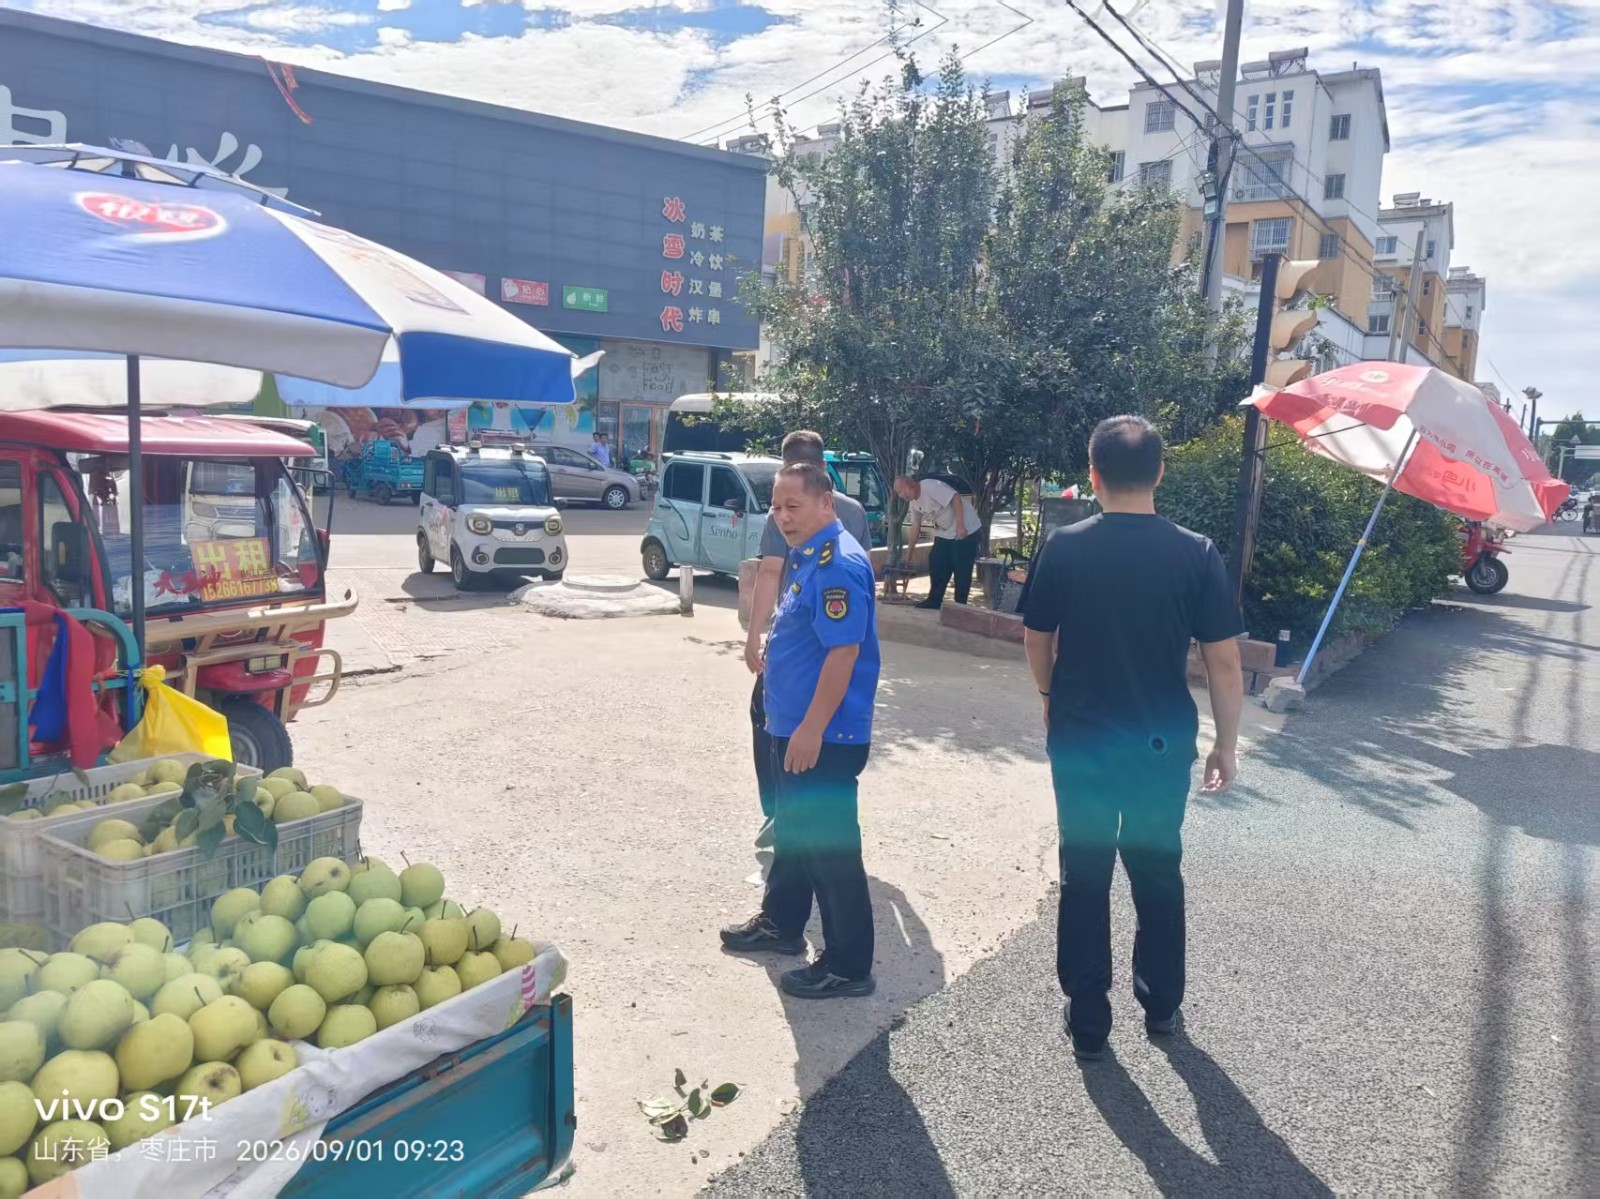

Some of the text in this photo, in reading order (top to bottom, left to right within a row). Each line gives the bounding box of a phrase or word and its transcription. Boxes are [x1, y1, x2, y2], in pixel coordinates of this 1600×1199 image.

[690, 221, 724, 242] 奶茶
[660, 196, 686, 332] 冰雪时代
[690, 250, 724, 271] 冷饮
[688, 279, 722, 298] 汉堡
[688, 307, 721, 326] 炸串
[196, 540, 271, 580] 出租
